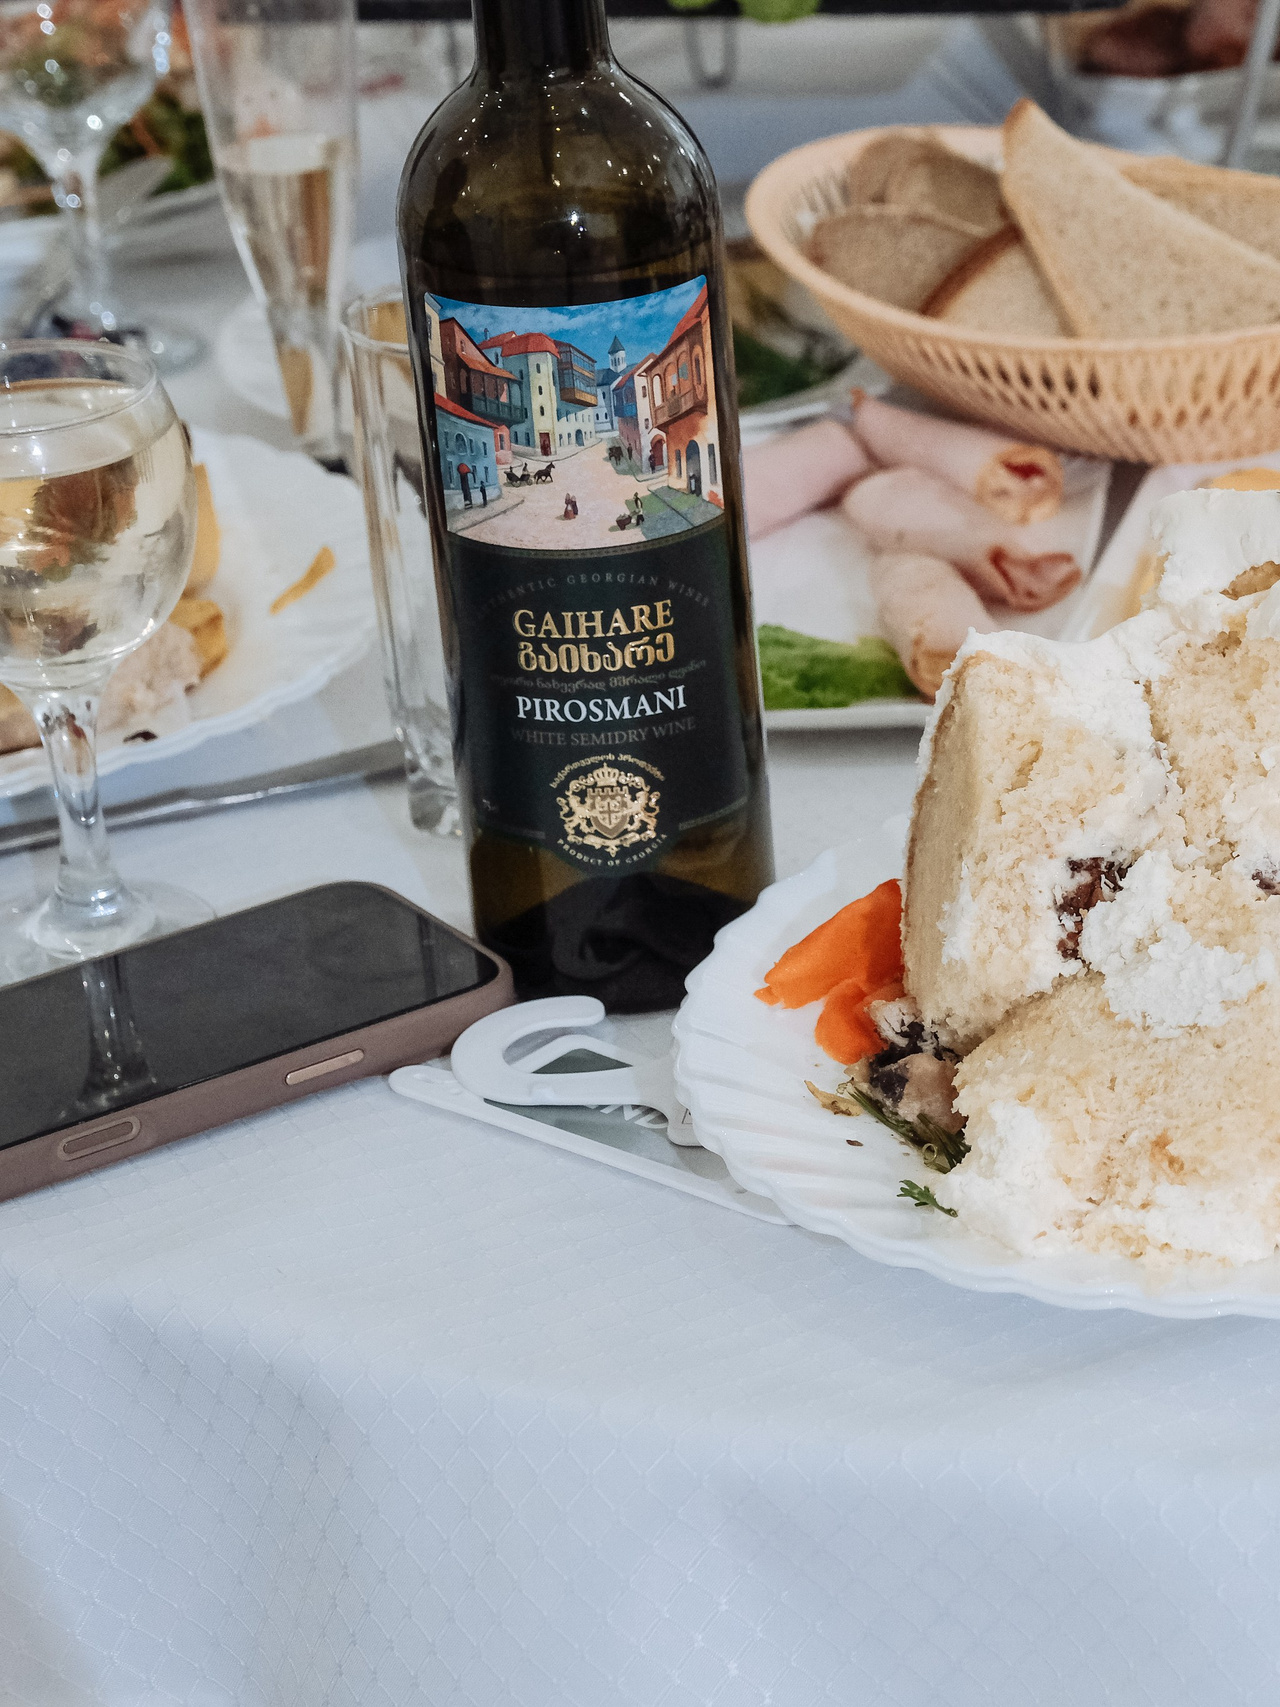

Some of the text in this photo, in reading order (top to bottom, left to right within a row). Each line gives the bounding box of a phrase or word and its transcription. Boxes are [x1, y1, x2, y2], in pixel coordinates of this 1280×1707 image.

[566, 572, 658, 586] GEORGIAN
[512, 599, 675, 639] GAIHARE
[517, 632, 675, 673] გაიხარე
[515, 685, 687, 723] PIROSMANI
[511, 716, 696, 746] WHITE SEMIDRY WINE
[556, 833, 668, 867] PRODUCT OF GEORGIA
